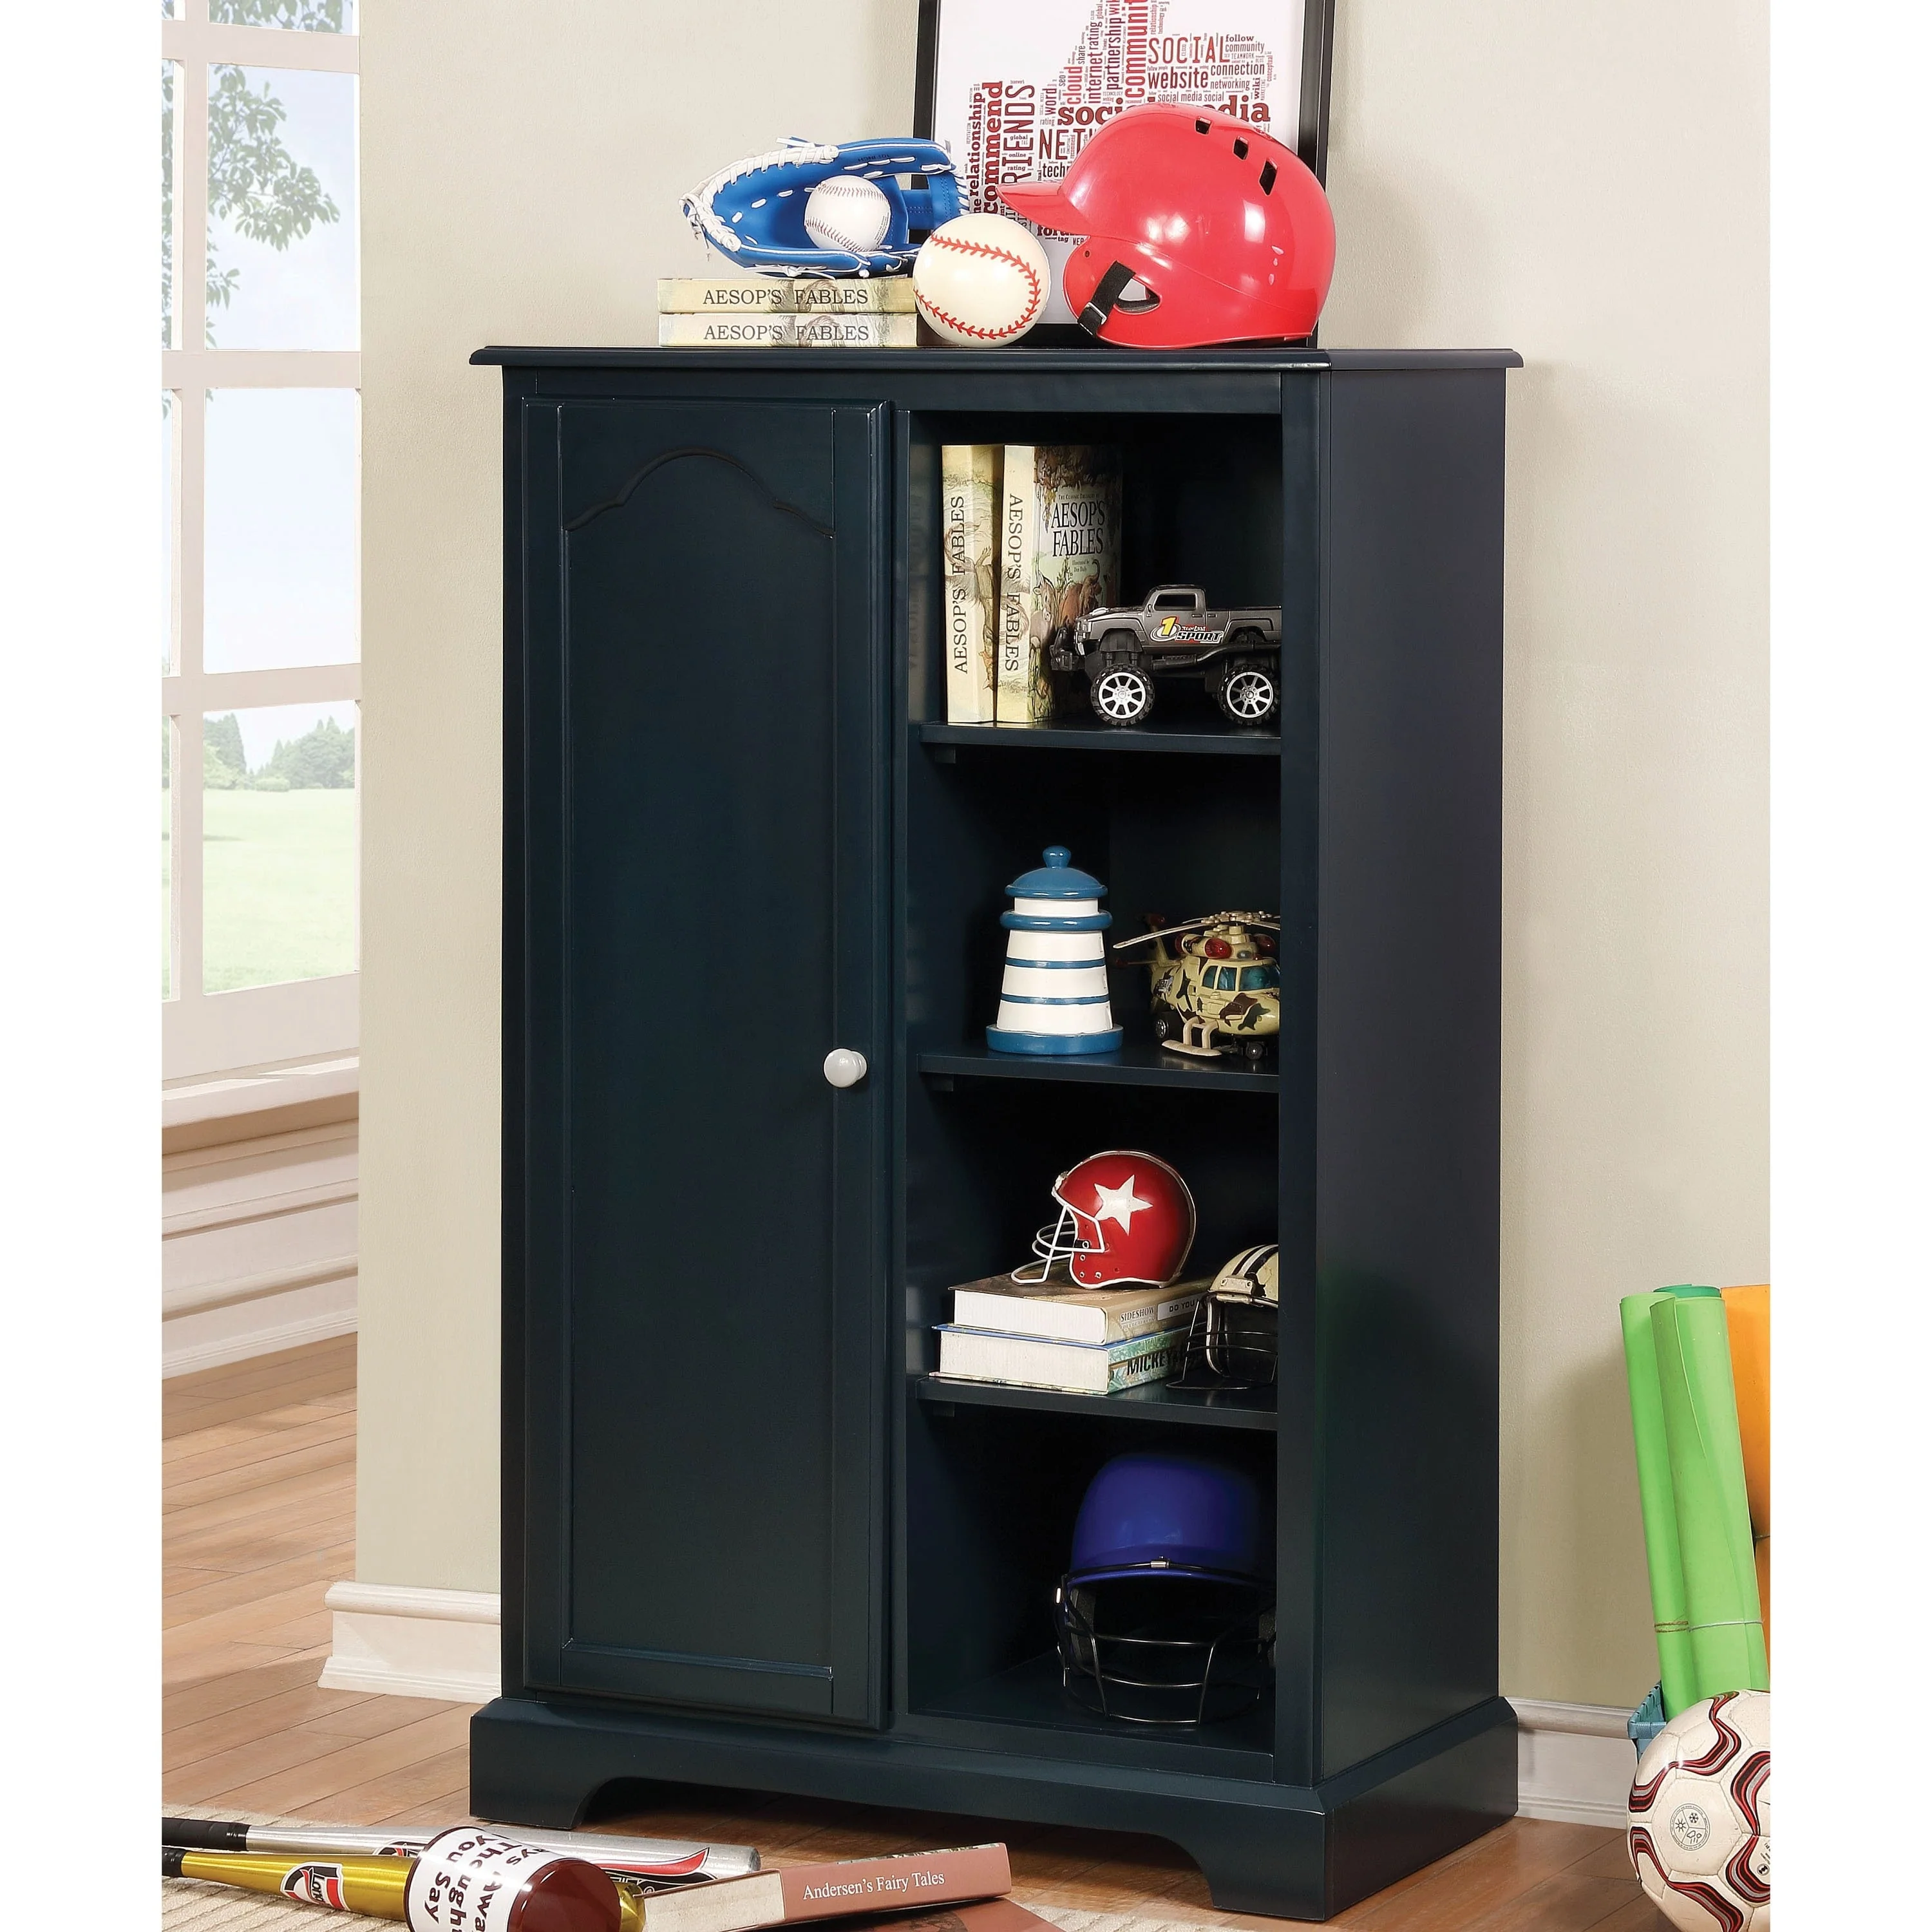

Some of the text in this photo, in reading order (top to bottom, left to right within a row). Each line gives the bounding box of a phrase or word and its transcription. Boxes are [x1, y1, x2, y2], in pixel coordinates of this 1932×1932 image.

[1095, 3, 1104, 19] global
[1106, 0, 1120, 15] wi
[1087, 21, 1103, 50] rating
[1148, 35, 1230, 64] SOCIAL
[1225, 41, 1265, 54] community
[1076, 45, 1086, 64] share
[1104, 17, 1126, 91] partnership
[1084, 52, 1103, 104] internet
[1148, 66, 1209, 90] website
[1211, 61, 1265, 76] connection
[1063, 66, 1083, 104] cloud
[1181, 91, 1202, 102] media
[1204, 91, 1224, 102] social
[1210, 78, 1250, 91] networking
[1042, 88, 1057, 116] word
[1001, 85, 1035, 187] RIENDS
[1040, 117, 1056, 127] rating
[967, 92, 985, 196] relationship
[1039, 128, 1096, 160] NET
[703, 289, 868, 305] AESOP'S FABLES
[703, 325, 869, 341] AESOP'S FABLES
[1051, 500, 1105, 528] AESOP'S
[1053, 527, 1103, 556] FABLES
[951, 496, 968, 674] AESOP'S FABLES
[1005, 493, 1023, 671] AESOP'S FABLES
[1161, 616, 1177, 636] 1
[1177, 632, 1222, 641] SPORT
[1121, 1305, 1154, 1322] SIDESHOW
[1169, 1300, 1195, 1312] DO YOU
[424, 1871, 451, 1924] Say
[803, 1870, 945, 1900] Andersen's Fairy Tales
[472, 1870, 505, 1932] Awa
